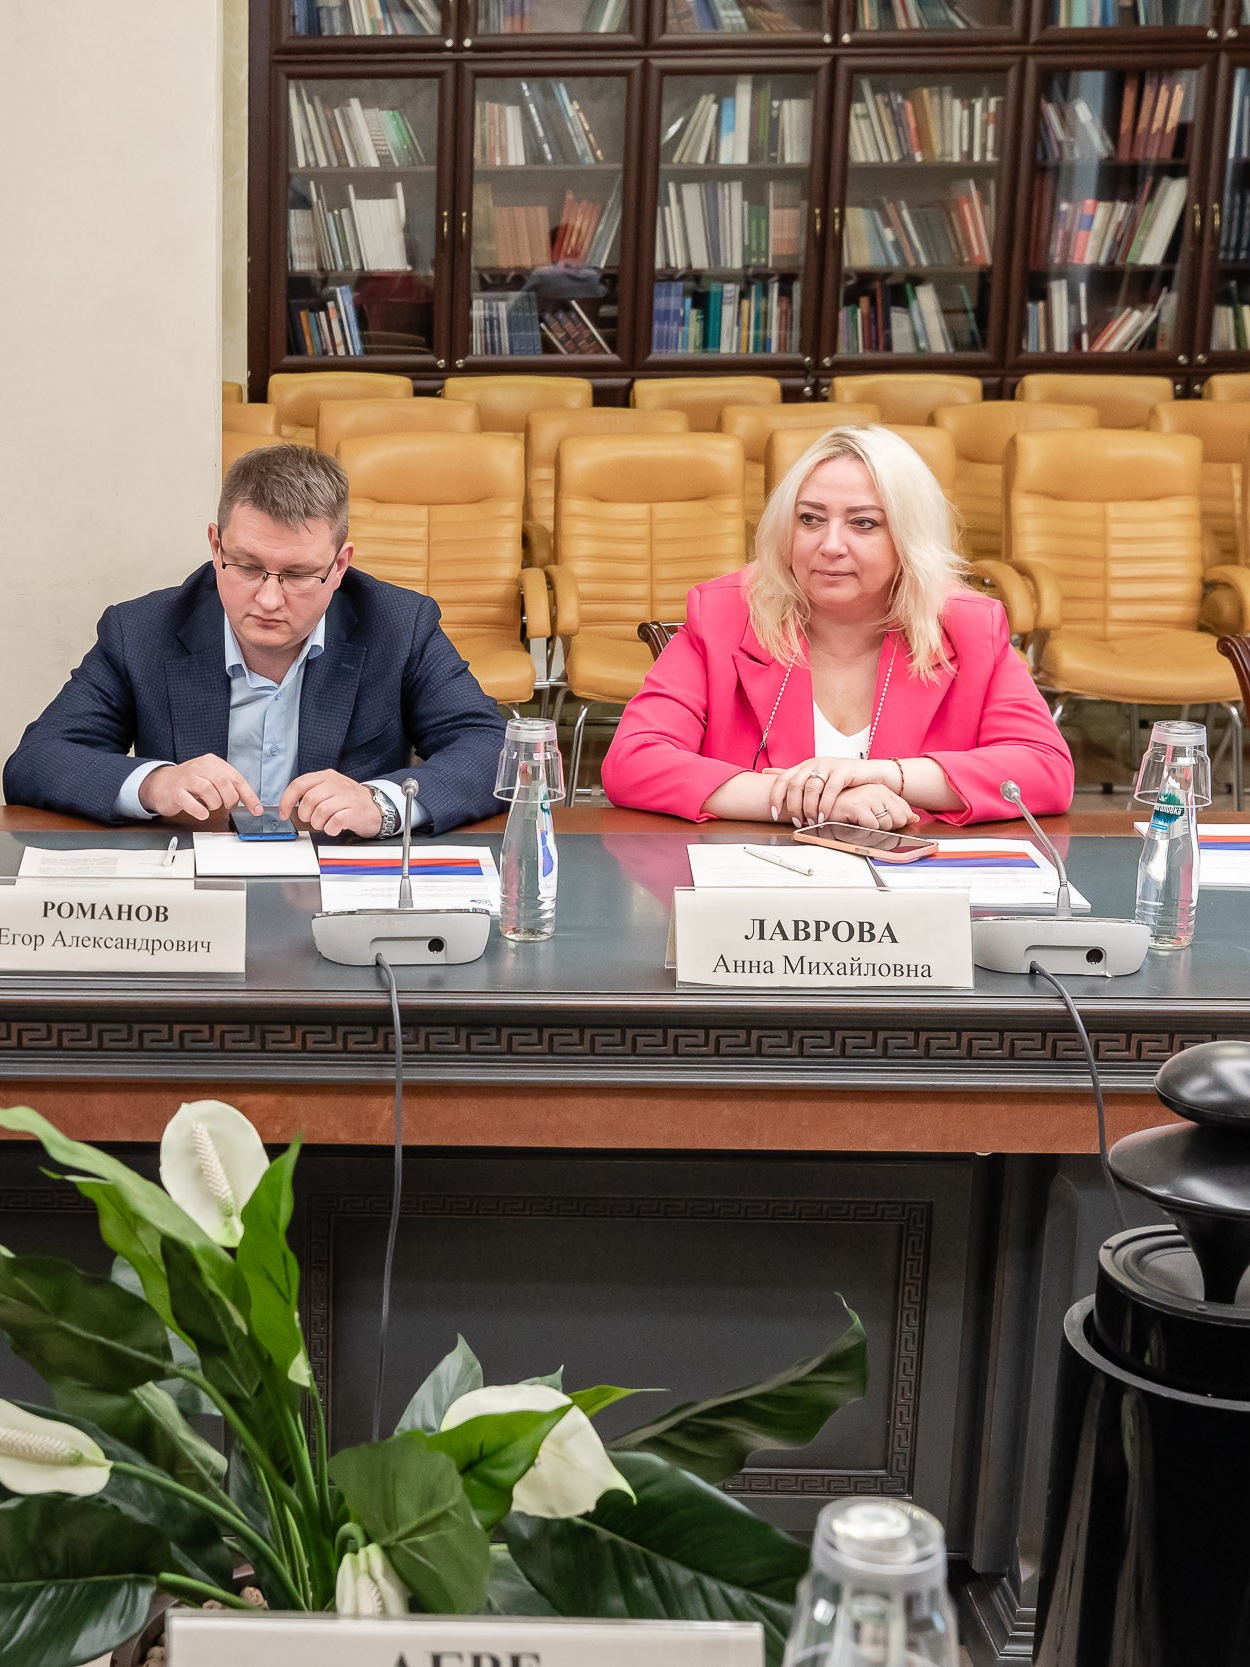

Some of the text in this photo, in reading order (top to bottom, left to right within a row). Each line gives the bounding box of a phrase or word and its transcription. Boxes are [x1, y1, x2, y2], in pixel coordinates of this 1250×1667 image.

[42, 900, 169, 923] РОМАНОВ
[51, 930, 212, 955] Александрович
[744, 918, 899, 944] ЛАВРОВА
[712, 953, 933, 978] Анна Михайловна
